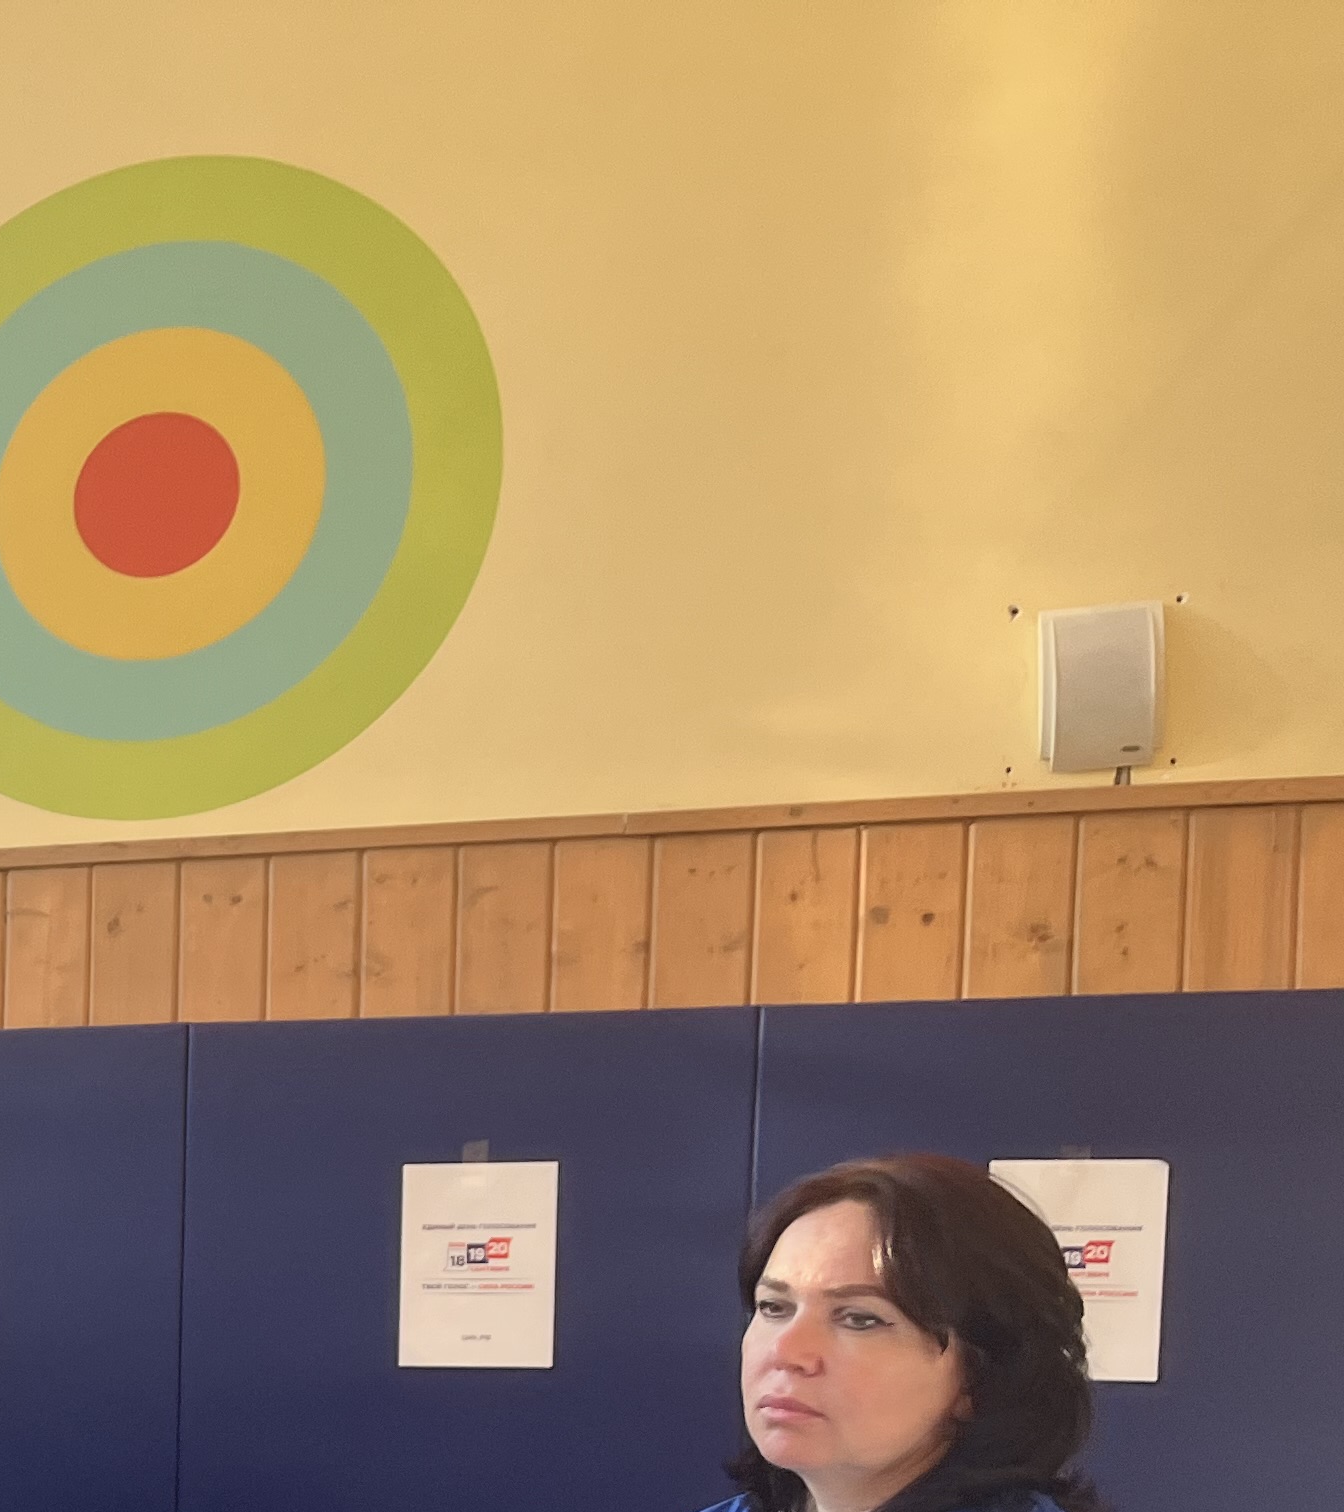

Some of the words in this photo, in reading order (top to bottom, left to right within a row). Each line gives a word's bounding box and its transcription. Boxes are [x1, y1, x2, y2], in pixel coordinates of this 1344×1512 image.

[468, 1247, 485, 1262] 19
[487, 1241, 508, 1255] 20
[1084, 1245, 1108, 1260] 20
